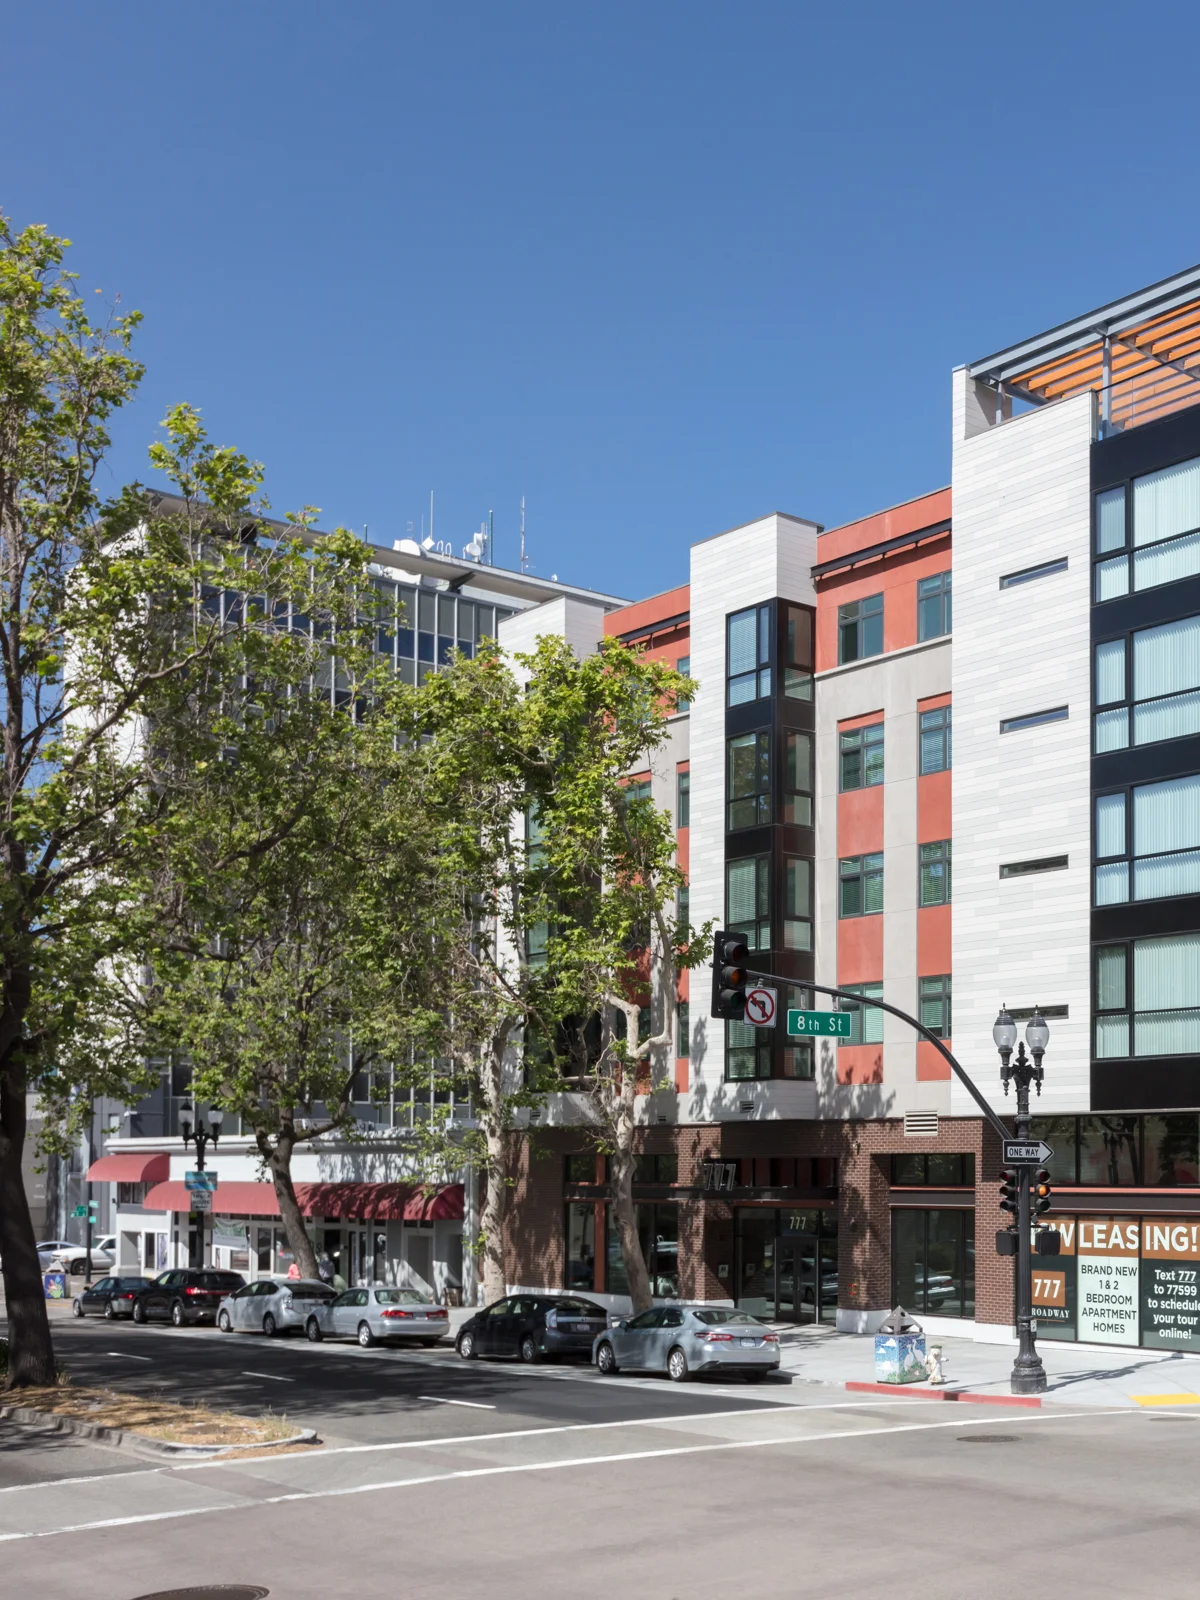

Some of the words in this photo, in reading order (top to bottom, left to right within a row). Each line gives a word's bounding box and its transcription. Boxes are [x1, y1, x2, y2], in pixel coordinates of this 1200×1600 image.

[797, 1015, 820, 1031] 8th
[828, 1017, 843, 1032] St
[1009, 1147, 1023, 1157] ONE
[1025, 1148, 1039, 1157] WAY
[703, 1163, 737, 1191] 777
[789, 1216, 807, 1230] 777
[1081, 1264, 1113, 1277] BRAND
[1115, 1266, 1138, 1277] NEW
[1154, 1269, 1176, 1281] Text
[1178, 1271, 1197, 1282] 777
[1034, 1278, 1061, 1299] 777
[1099, 1280, 1103, 1290] 1
[1104, 1281, 1111, 1290] &
[1113, 1281, 1119, 1290] 2
[1154, 1284, 1164, 1295] to
[1166, 1284, 1197, 1297] 77599
[1086, 1293, 1133, 1305] BEDROOM
[1148, 1298, 1159, 1308] to
[1031, 1307, 1070, 1319] ROADWAY
[1081, 1307, 1137, 1320] APARTMENT
[1153, 1314, 1174, 1325] your
[1177, 1314, 1199, 1326] tour
[1093, 1322, 1125, 1334] HOMES
[1159, 1327, 1192, 1340] online!
